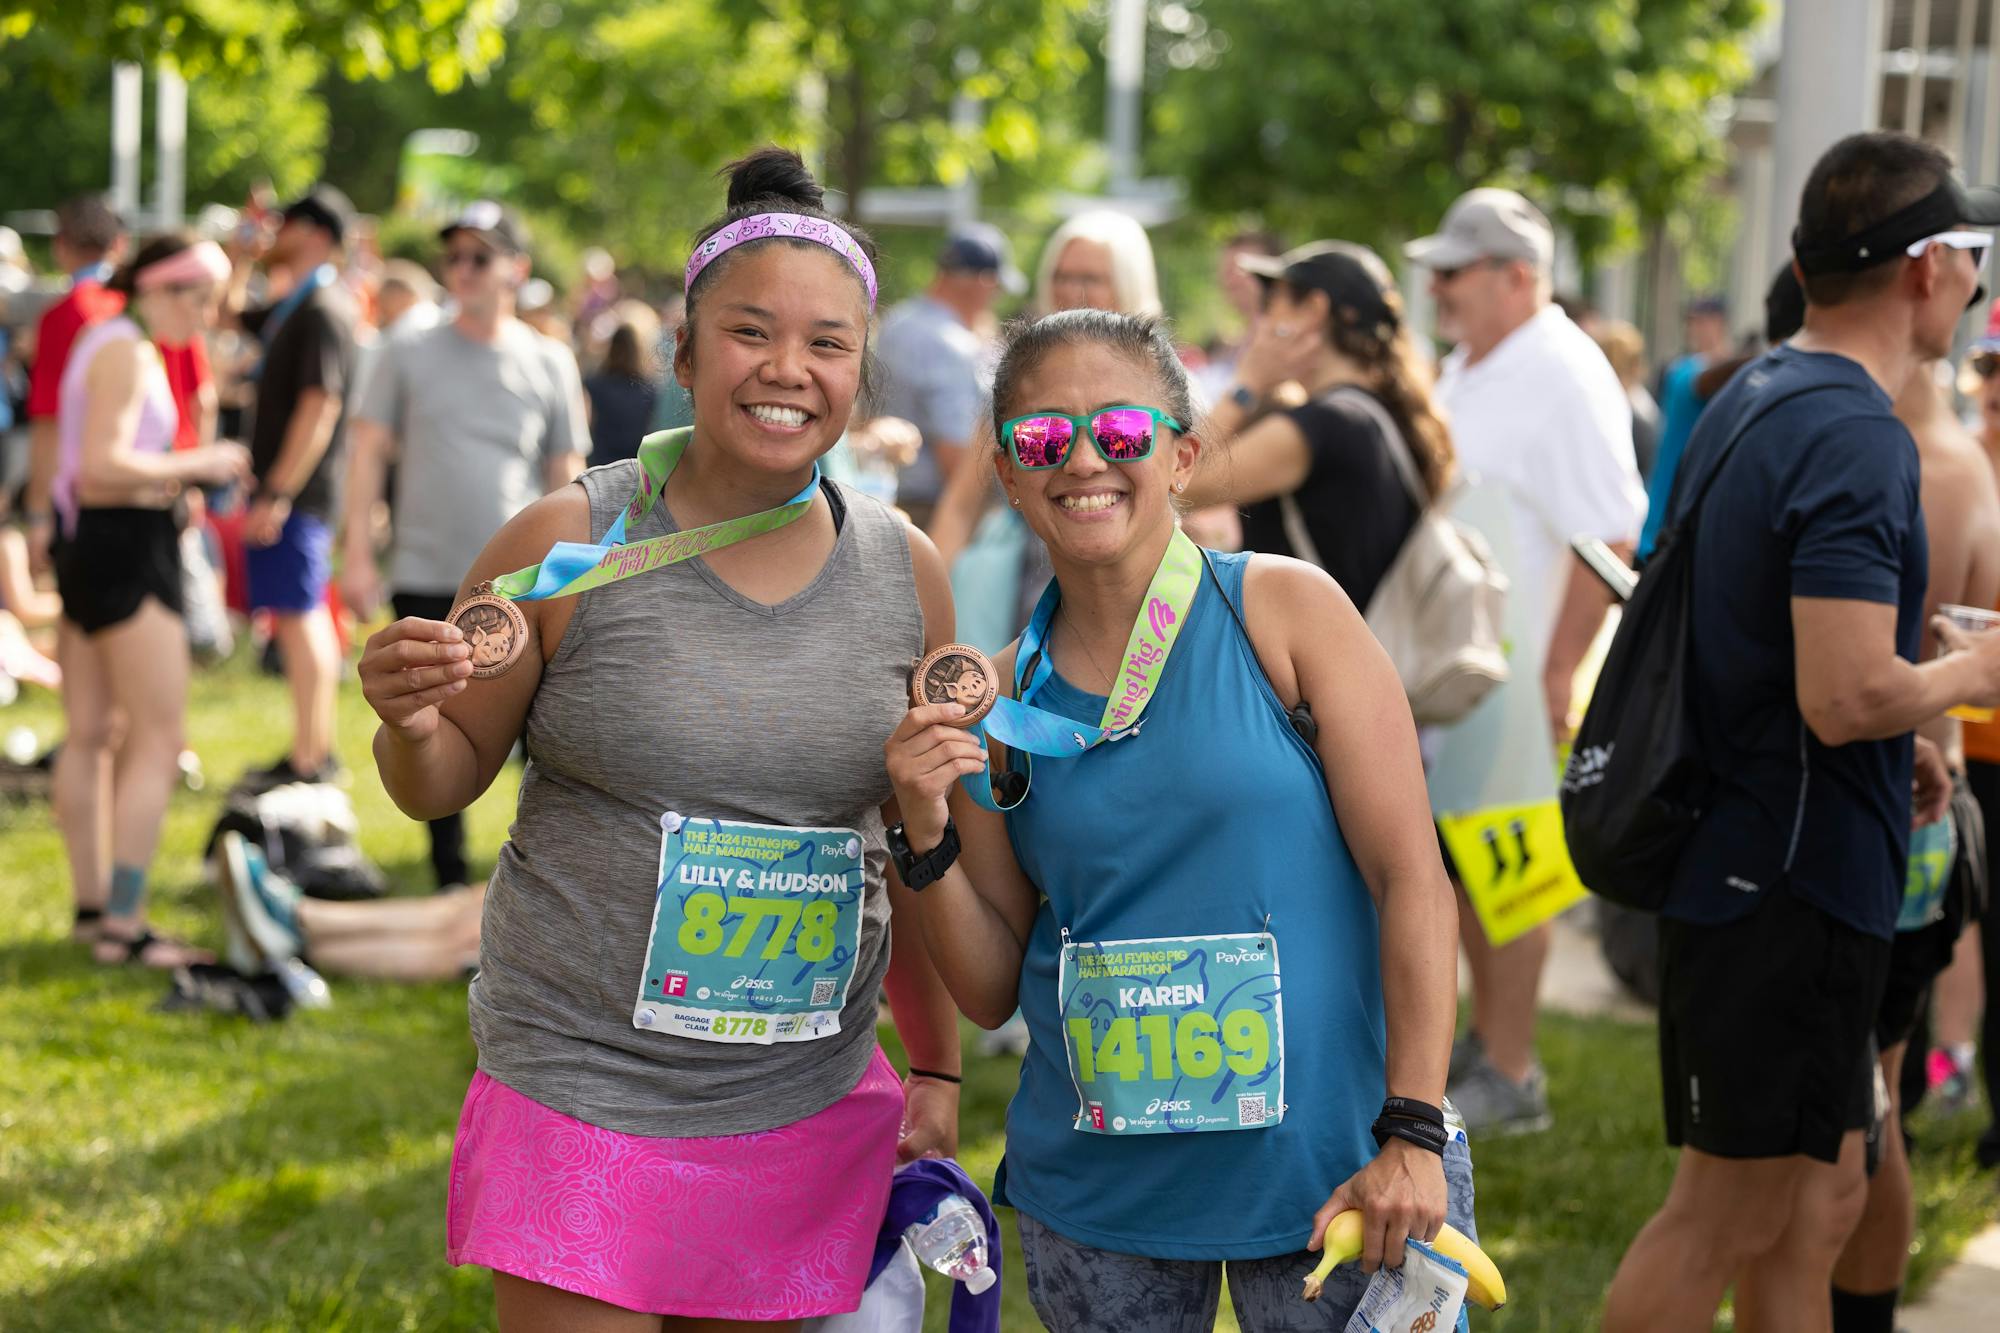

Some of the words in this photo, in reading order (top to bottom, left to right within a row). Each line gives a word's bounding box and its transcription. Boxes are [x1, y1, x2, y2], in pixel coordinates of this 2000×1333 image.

[492, 596, 507, 606] HALF
[505, 603, 526, 634] MARATHON
[934, 647, 948, 656] HALF
[949, 645, 983, 659] MARATHON
[1125, 638, 1163, 682] Pig
[986, 687, 994, 702] 2024
[685, 831, 707, 842] THE
[709, 832, 740, 846] 2024
[741, 835, 782, 849] FLYING
[782, 839, 800, 850] PIG
[683, 843, 716, 855] HALF
[716, 845, 784, 861] MARATHON
[821, 844, 846, 858] Payc
[680, 864, 734, 887] LILLY
[736, 869, 755, 890] &
[758, 871, 847, 893] HUDSON
[677, 892, 839, 963] 8778
[1078, 954, 1095, 967] THE
[1095, 952, 1123, 966] 2024
[1125, 950, 1165, 964] FLYING
[1166, 949, 1188, 961] PIG
[1215, 951, 1267, 966] Paycor
[1079, 966, 1103, 978] HALF
[1103, 964, 1172, 977] MARATHON
[668, 976, 683, 993] F
[1119, 984, 1205, 1008] KAREN
[674, 1013, 710, 1024] BAGGAGE
[711, 1016, 769, 1037] 8778
[684, 1023, 709, 1033] CLAIM
[1068, 1009, 1269, 1082] 14169
